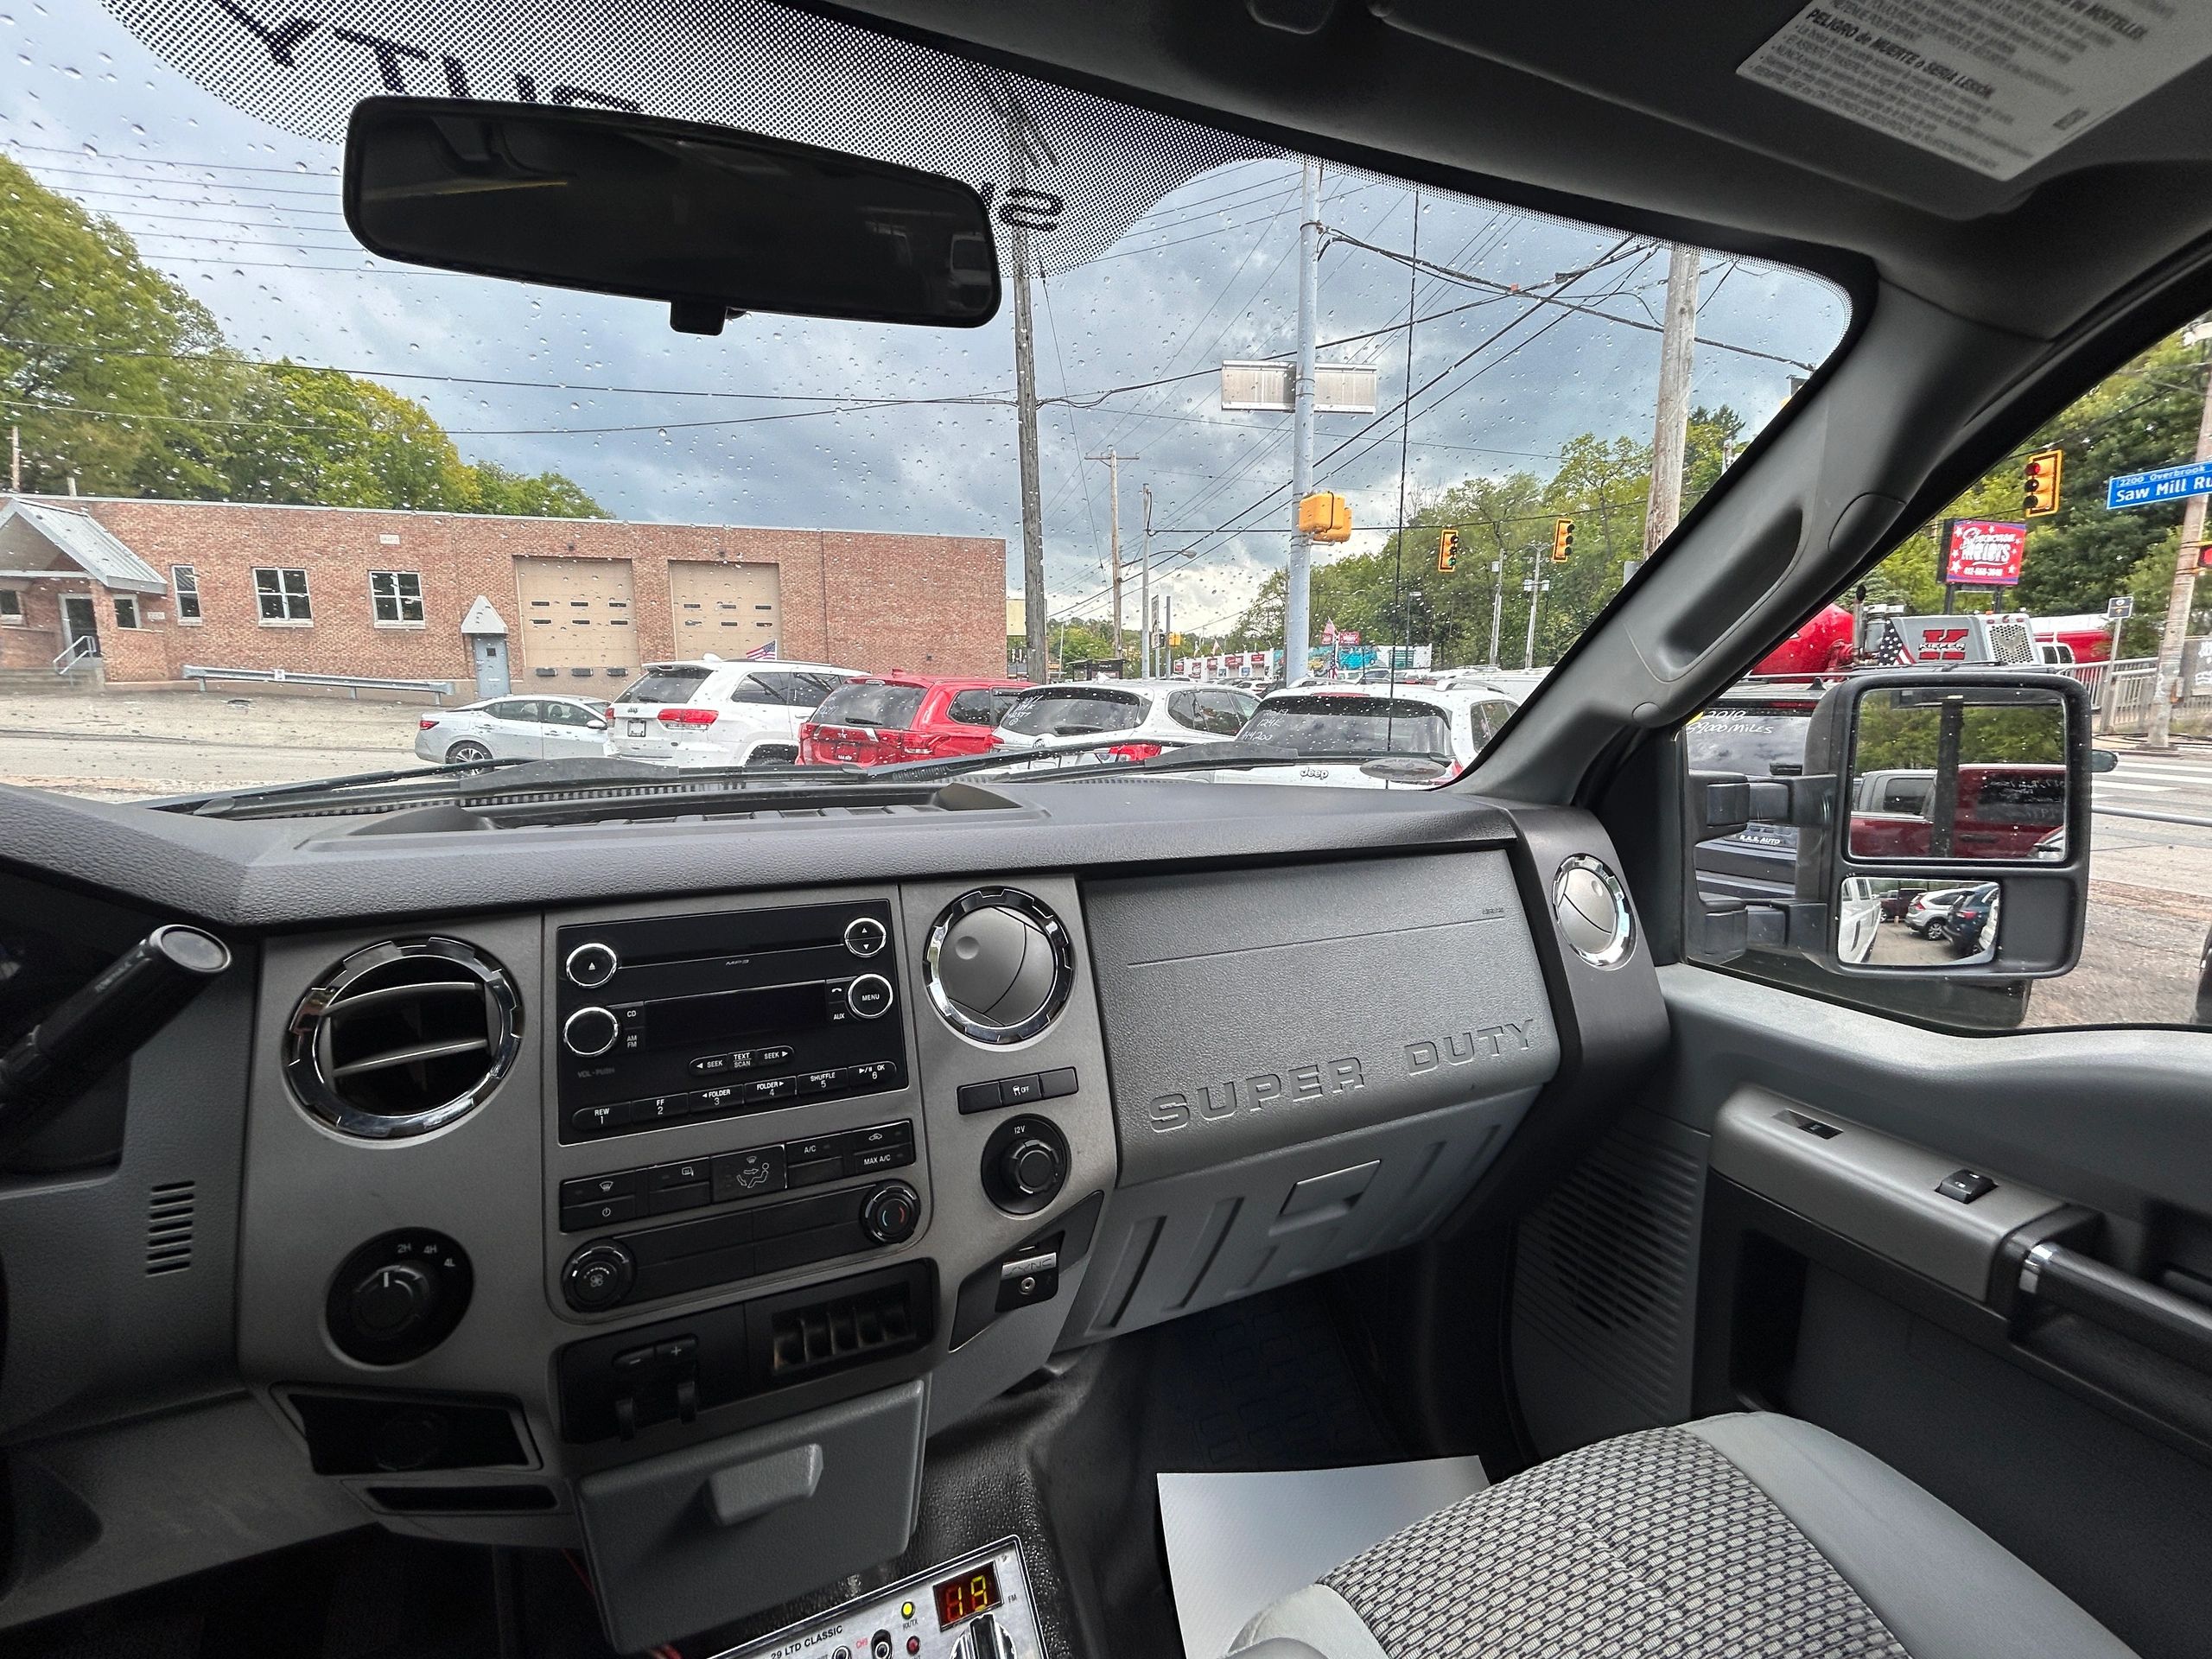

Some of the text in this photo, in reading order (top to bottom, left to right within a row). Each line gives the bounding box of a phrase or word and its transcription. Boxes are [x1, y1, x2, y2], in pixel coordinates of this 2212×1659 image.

[1805, 7, 1859, 38] PELIGRO
[2120, 466, 2205, 486] 2200 Overbrook
[2116, 487, 2150, 502] Saw
[2156, 478, 2187, 496] Mill
[1702, 709, 1745, 721] 2018
[1300, 767, 1329, 779] Jeep
[861, 993, 880, 1001] MENU
[764, 1052, 779, 1060] SEEK
[707, 1059, 723, 1068] SEEK
[810, 1072, 836, 1082] SHUFFLE
[872, 1071, 878, 1080] 6
[1150, 1019, 1534, 1134] SUPER DUTY
[756, 1082, 779, 1090] FOLDER
[821, 1080, 827, 1089] 5
[709, 1089, 731, 1098] FOLDER
[656, 1098, 664, 1107] FF
[714, 1097, 720, 1106] 3
[594, 1108, 610, 1116] REW
[657, 1106, 664, 1116] 2
[600, 1116, 604, 1124] 1
[1014, 1125, 1026, 1135] 12V
[804, 1145, 817, 1154] A/C
[864, 1154, 891, 1166] MAX A/C
[397, 1243, 411, 1253] 2H
[423, 1244, 438, 1255] 4H
[443, 1258, 456, 1268] 4L
[1007, 1593, 1017, 1604] FM
[771, 1624, 843, 1659] 29 LTD CLASSIC
